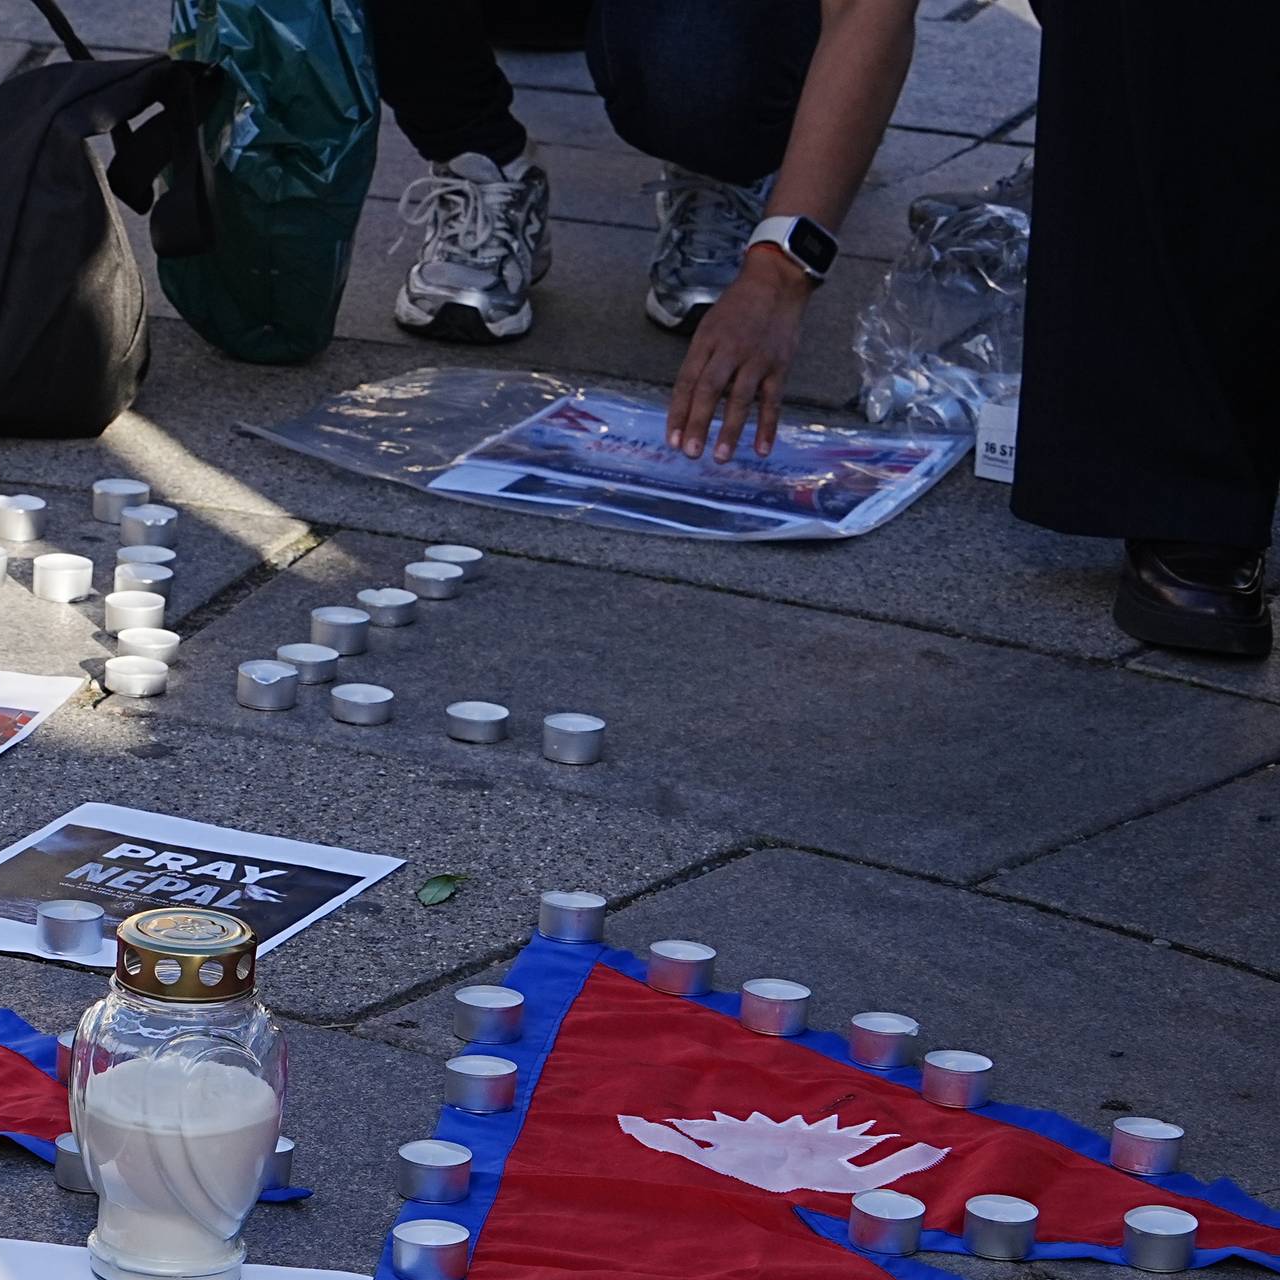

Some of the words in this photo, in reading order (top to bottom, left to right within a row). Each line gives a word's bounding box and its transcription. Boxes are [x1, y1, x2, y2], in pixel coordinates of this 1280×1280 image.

[984, 441, 997, 454] 16
[102, 842, 289, 884] PRAY
[64, 861, 244, 910] NEPAL
